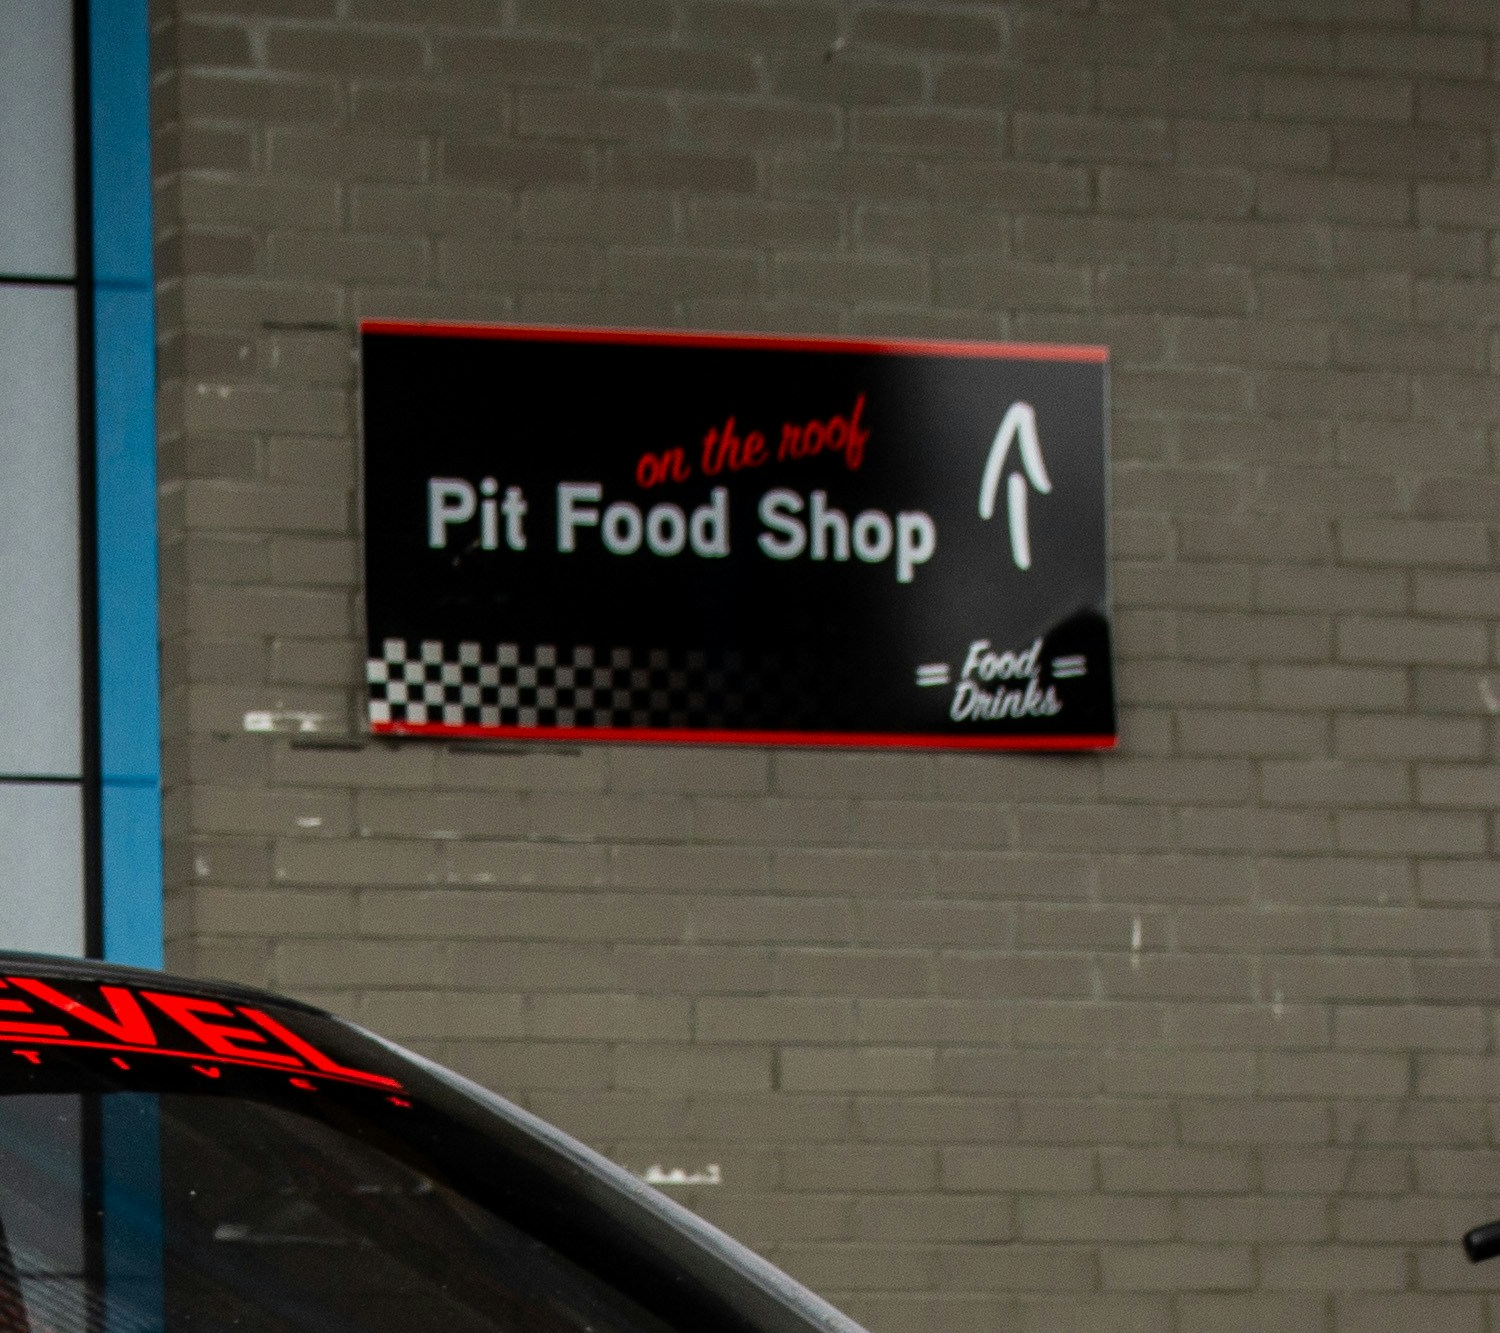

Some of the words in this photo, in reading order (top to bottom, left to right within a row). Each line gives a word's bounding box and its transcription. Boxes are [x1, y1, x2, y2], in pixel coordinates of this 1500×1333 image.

[635, 447, 690, 489] on
[700, 416, 766, 475] the
[777, 393, 869, 472] roof
[428, 477, 528, 549] Pit
[558, 483, 729, 556] Food
[760, 490, 937, 583] Shop
[961, 636, 1043, 681] Food
[951, 678, 1063, 722] Drinks
